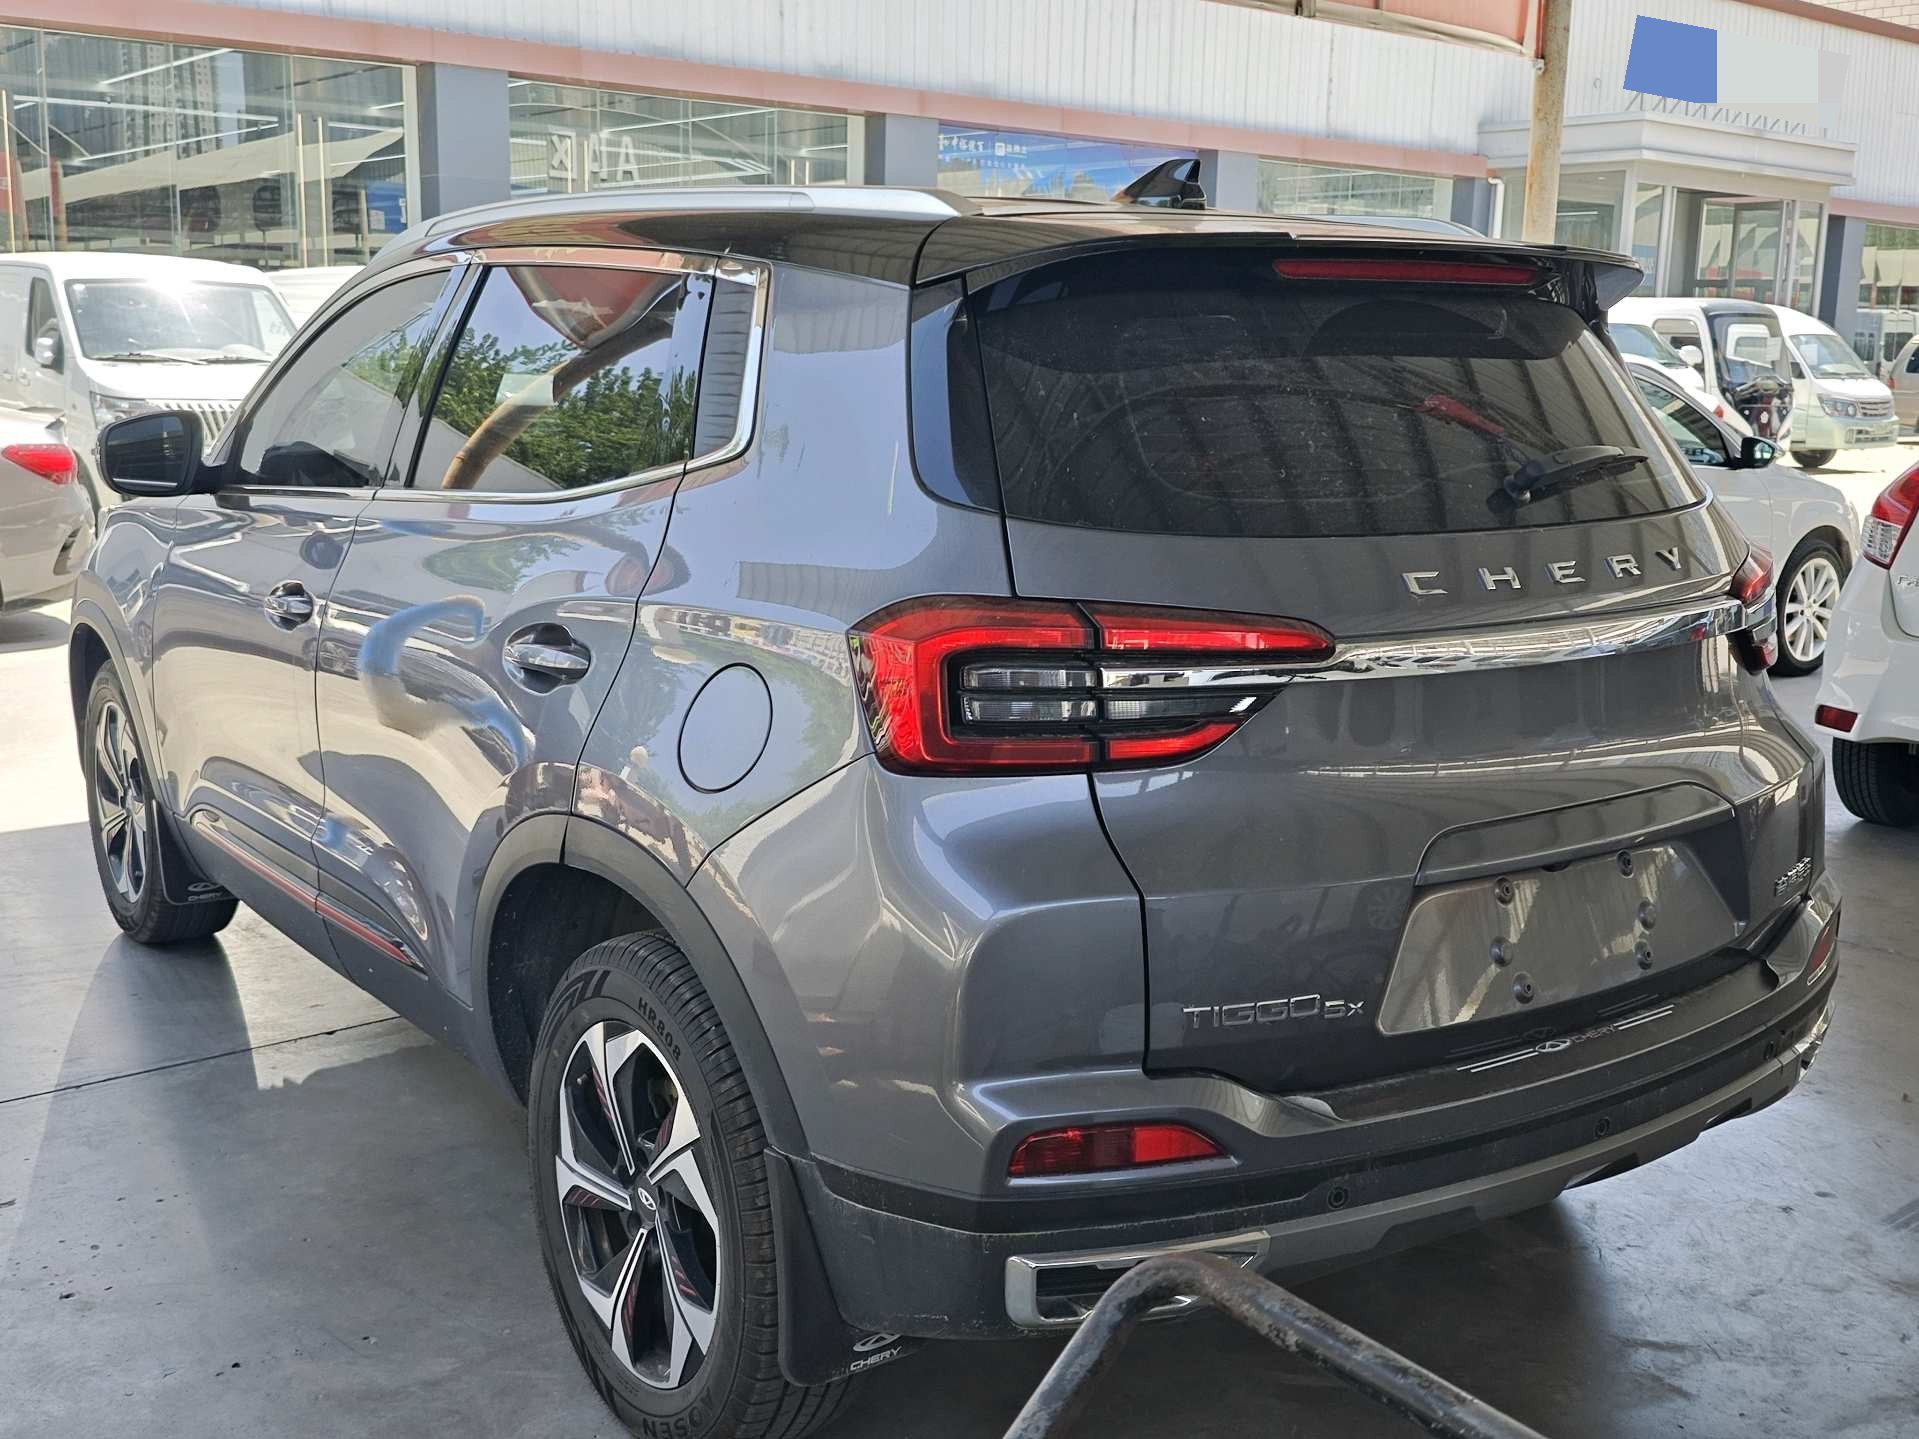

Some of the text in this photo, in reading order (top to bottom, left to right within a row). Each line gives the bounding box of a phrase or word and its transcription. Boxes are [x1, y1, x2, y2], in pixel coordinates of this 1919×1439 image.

[1401, 547, 1682, 596] CHERY
[637, 996, 682, 1062] HR808
[1182, 993, 1321, 1029] TIGGO
[1571, 1022, 1617, 1043] CHERY
[849, 1346, 903, 1371] CHERY
